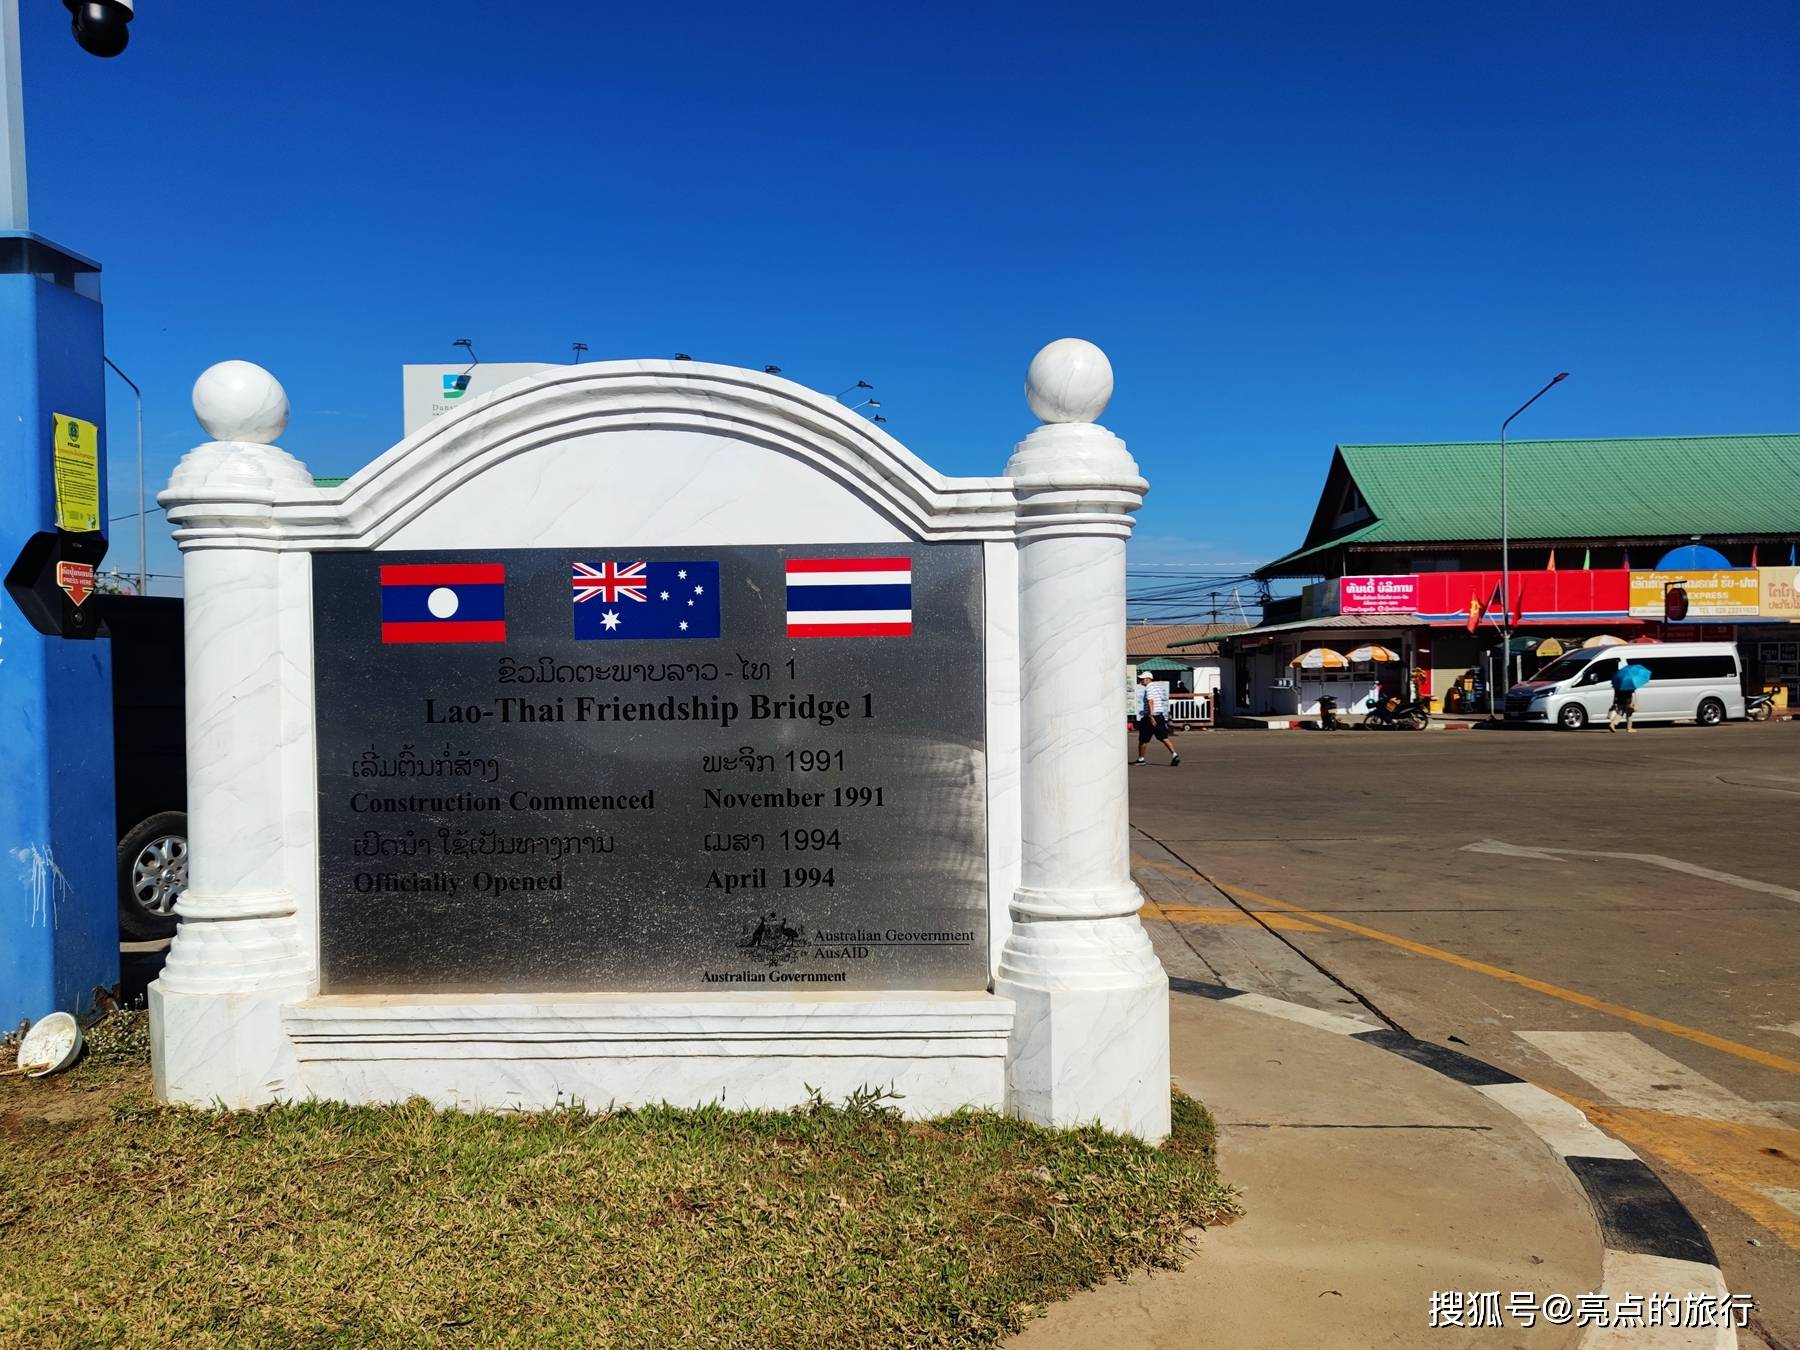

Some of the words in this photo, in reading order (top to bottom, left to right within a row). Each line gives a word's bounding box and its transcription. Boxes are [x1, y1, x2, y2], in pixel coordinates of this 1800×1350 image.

[63, 577, 79, 585] PRESS
[785, 658, 796, 680] 1
[424, 696, 565, 724] Lao-Thai
[574, 694, 739, 728] Friendship
[750, 693, 851, 727] Bridge
[861, 692, 875, 718] 1
[702, 746, 775, 773] ພະຈິກ
[785, 749, 845, 772] 1991
[350, 790, 501, 813] Construction
[509, 789, 654, 811] Commenced
[703, 787, 825, 809] November
[833, 786, 886, 808] 1991
[703, 832, 765, 852] ເມສາ
[780, 828, 842, 850] 1994
[353, 870, 462, 898] Officially
[472, 870, 563, 897] Opened
[704, 868, 767, 894] April
[783, 867, 836, 888] 1994
[814, 929, 882, 942] Australian
[885, 929, 975, 942] Geovernment
[814, 946, 870, 959] AusAID
[701, 970, 766, 983] Australian
[768, 970, 847, 983] Government
